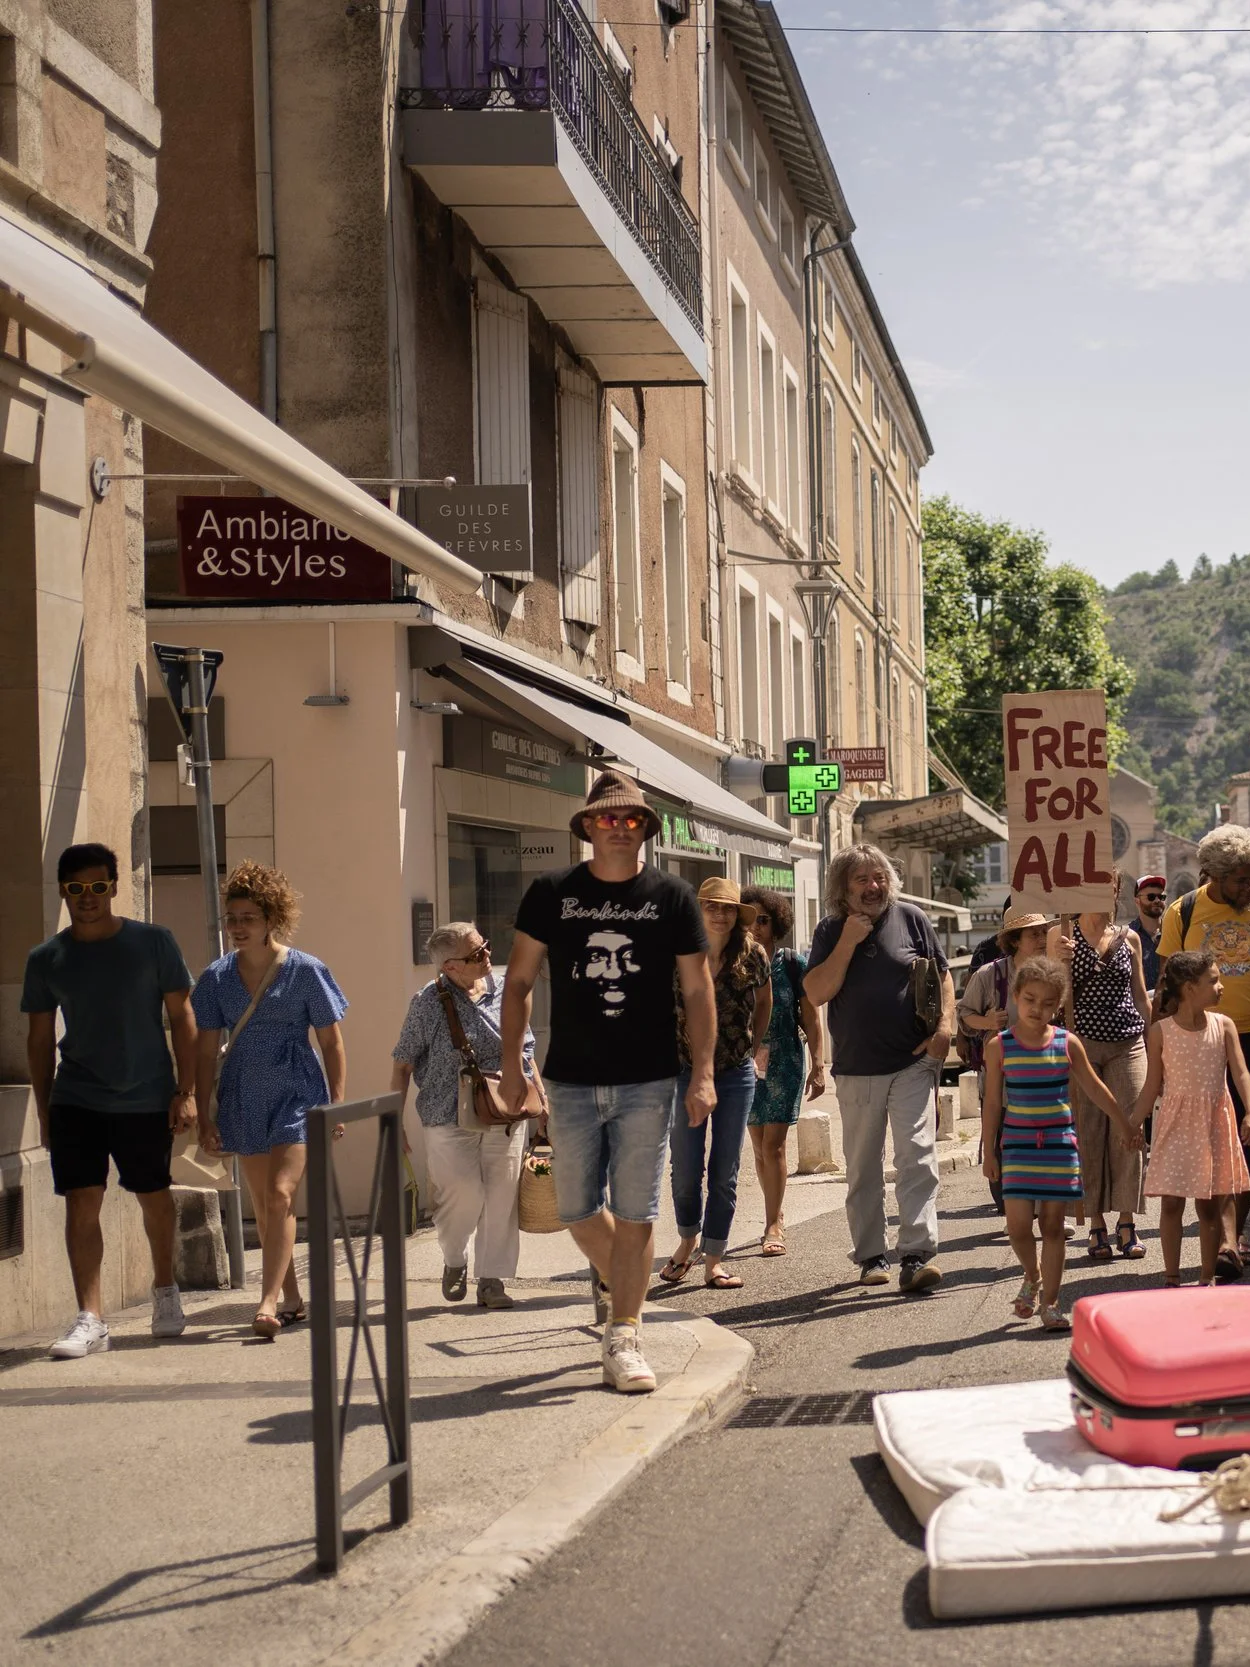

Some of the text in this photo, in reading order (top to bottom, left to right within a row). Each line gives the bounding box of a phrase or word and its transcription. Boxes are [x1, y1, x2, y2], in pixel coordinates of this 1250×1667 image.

[439, 503, 510, 517] GUILDE
[196, 509, 351, 541] Ambianc
[458, 521, 492, 535] DES
[444, 537, 523, 552] RFÈVRES
[1006, 707, 1108, 771] FREE
[830, 749, 885, 763] MAROQUINERIE
[844, 768, 884, 779] GAGERIE
[1024, 777, 1104, 823] FOR
[1012, 830, 1113, 893] ALL
[560, 897, 660, 921] Burkindi
